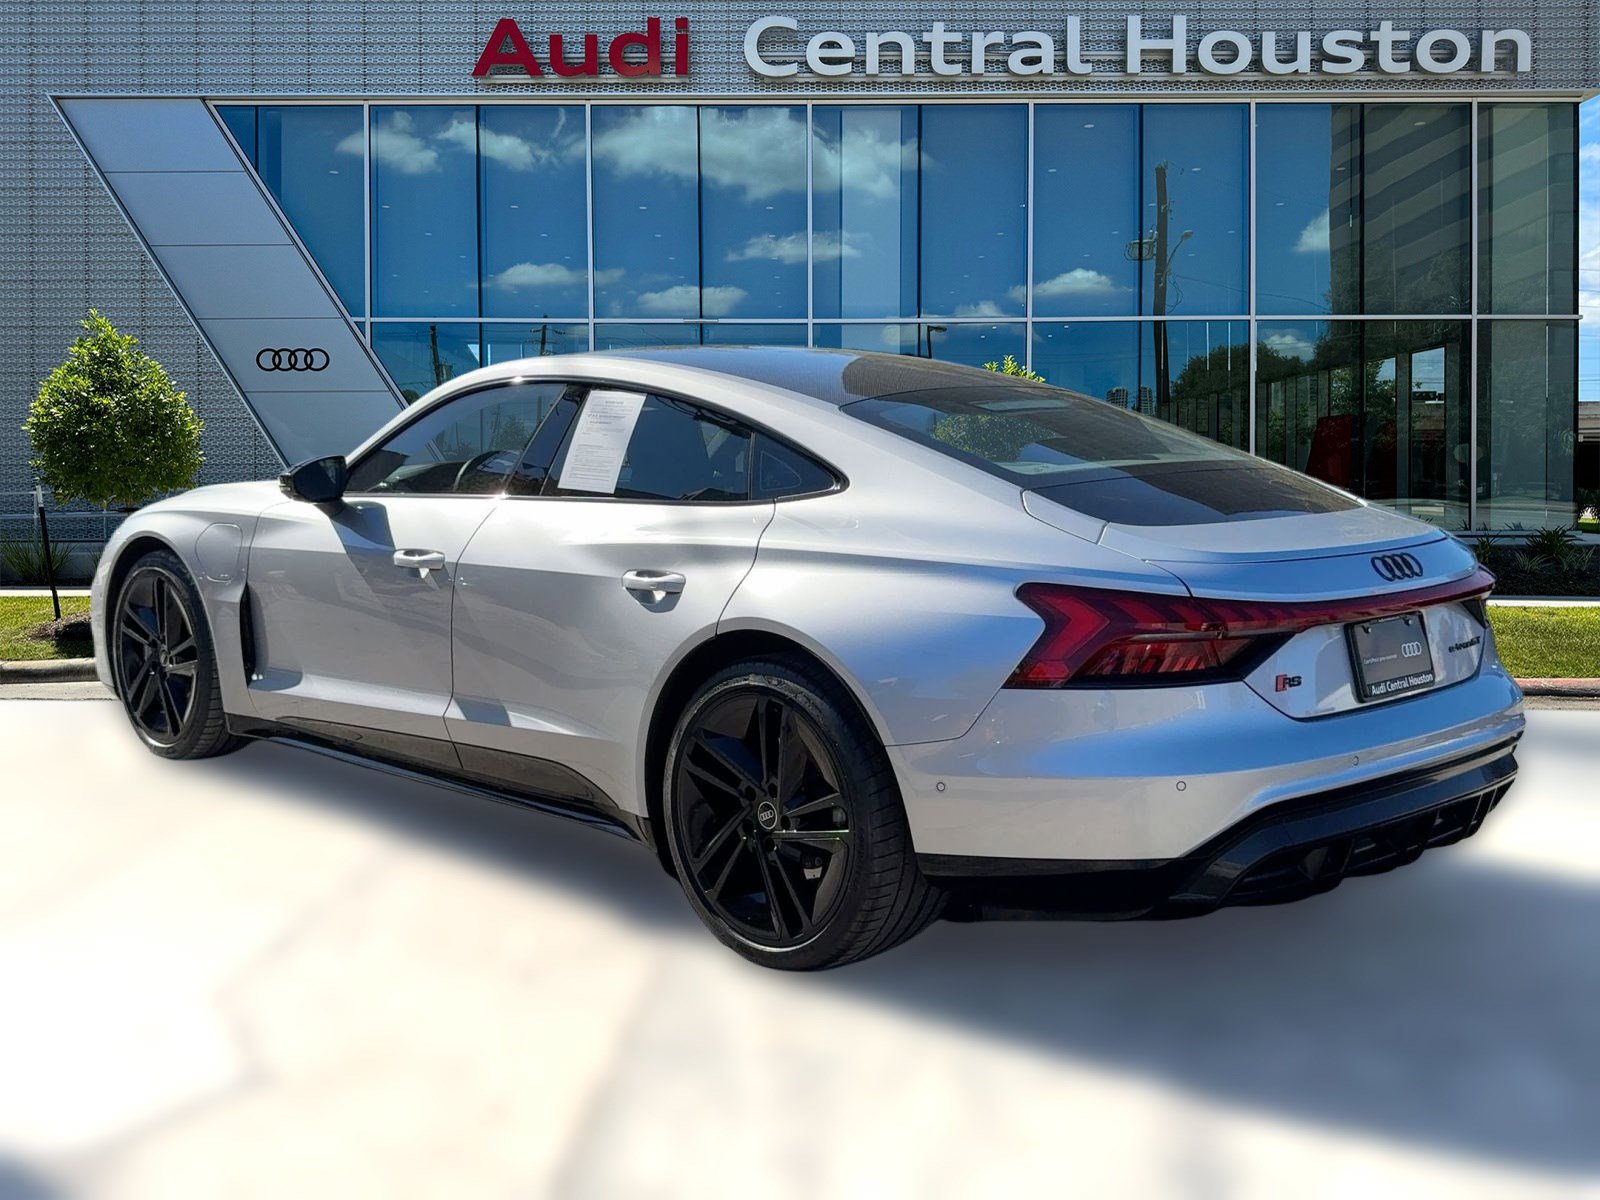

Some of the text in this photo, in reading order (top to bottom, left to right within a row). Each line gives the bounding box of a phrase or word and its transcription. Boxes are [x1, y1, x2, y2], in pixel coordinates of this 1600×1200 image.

[471, 14, 1532, 78] Audi Central Houston
[1275, 673, 1303, 692] RS
[1371, 673, 1434, 696] Audi Central Houston
